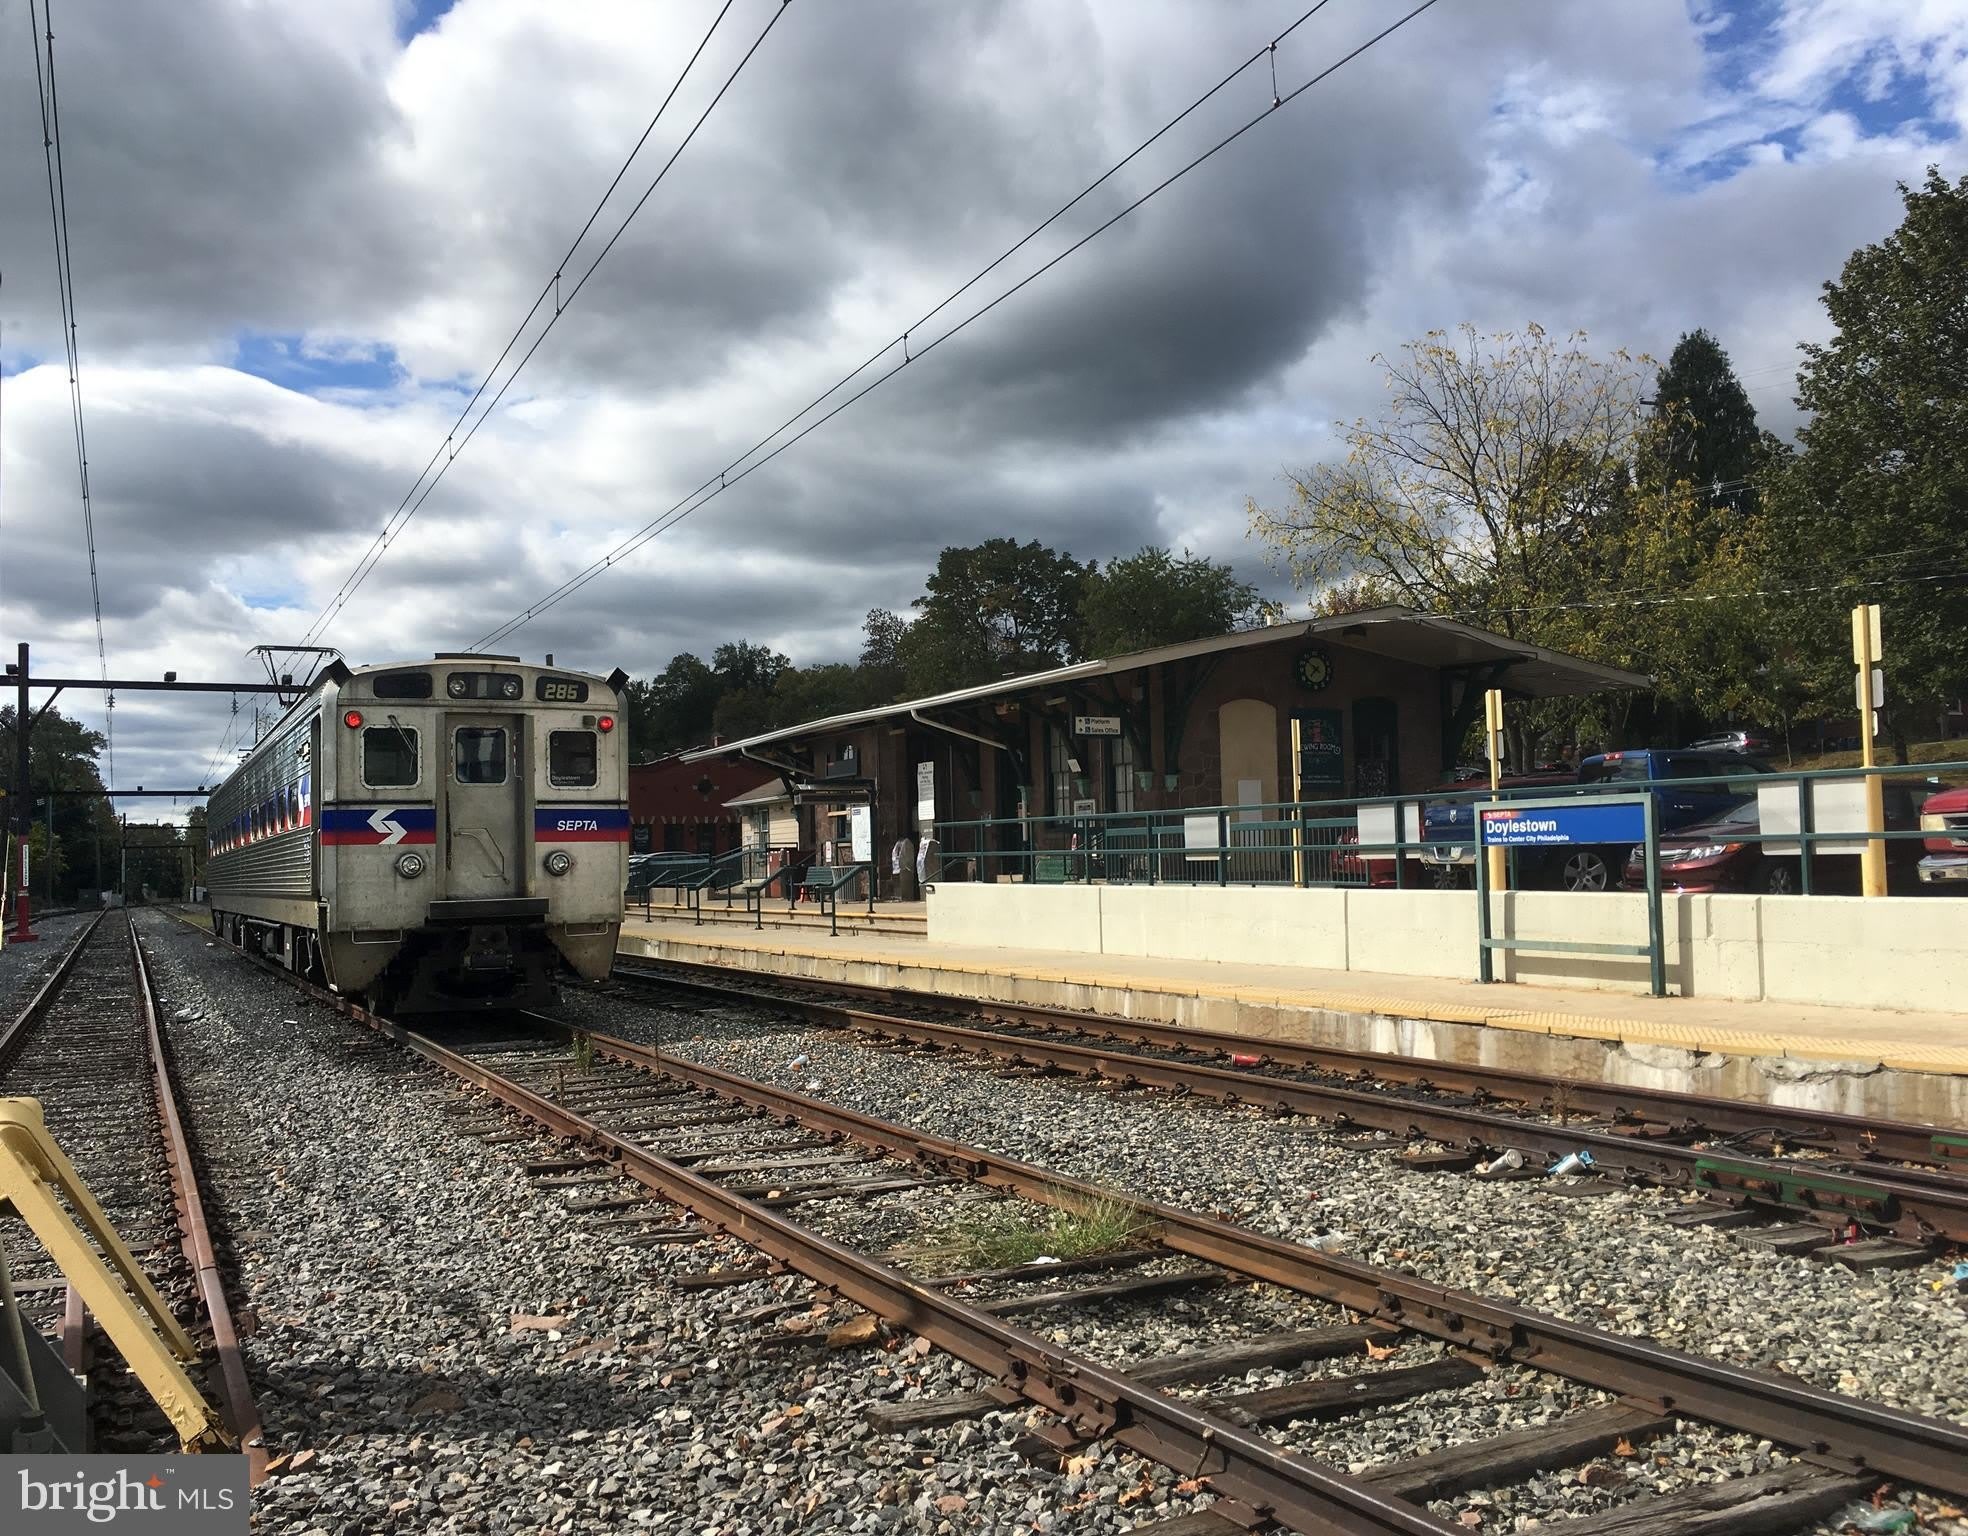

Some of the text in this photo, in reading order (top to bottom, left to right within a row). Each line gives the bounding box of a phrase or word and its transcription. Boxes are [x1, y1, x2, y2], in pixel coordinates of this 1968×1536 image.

[544, 683, 578, 700] 285
[557, 820, 598, 831] SEPTA
[1486, 819, 1556, 836] Doylestown
[1526, 835, 1536, 843] City
[1537, 834, 1569, 843] Philadelphia
